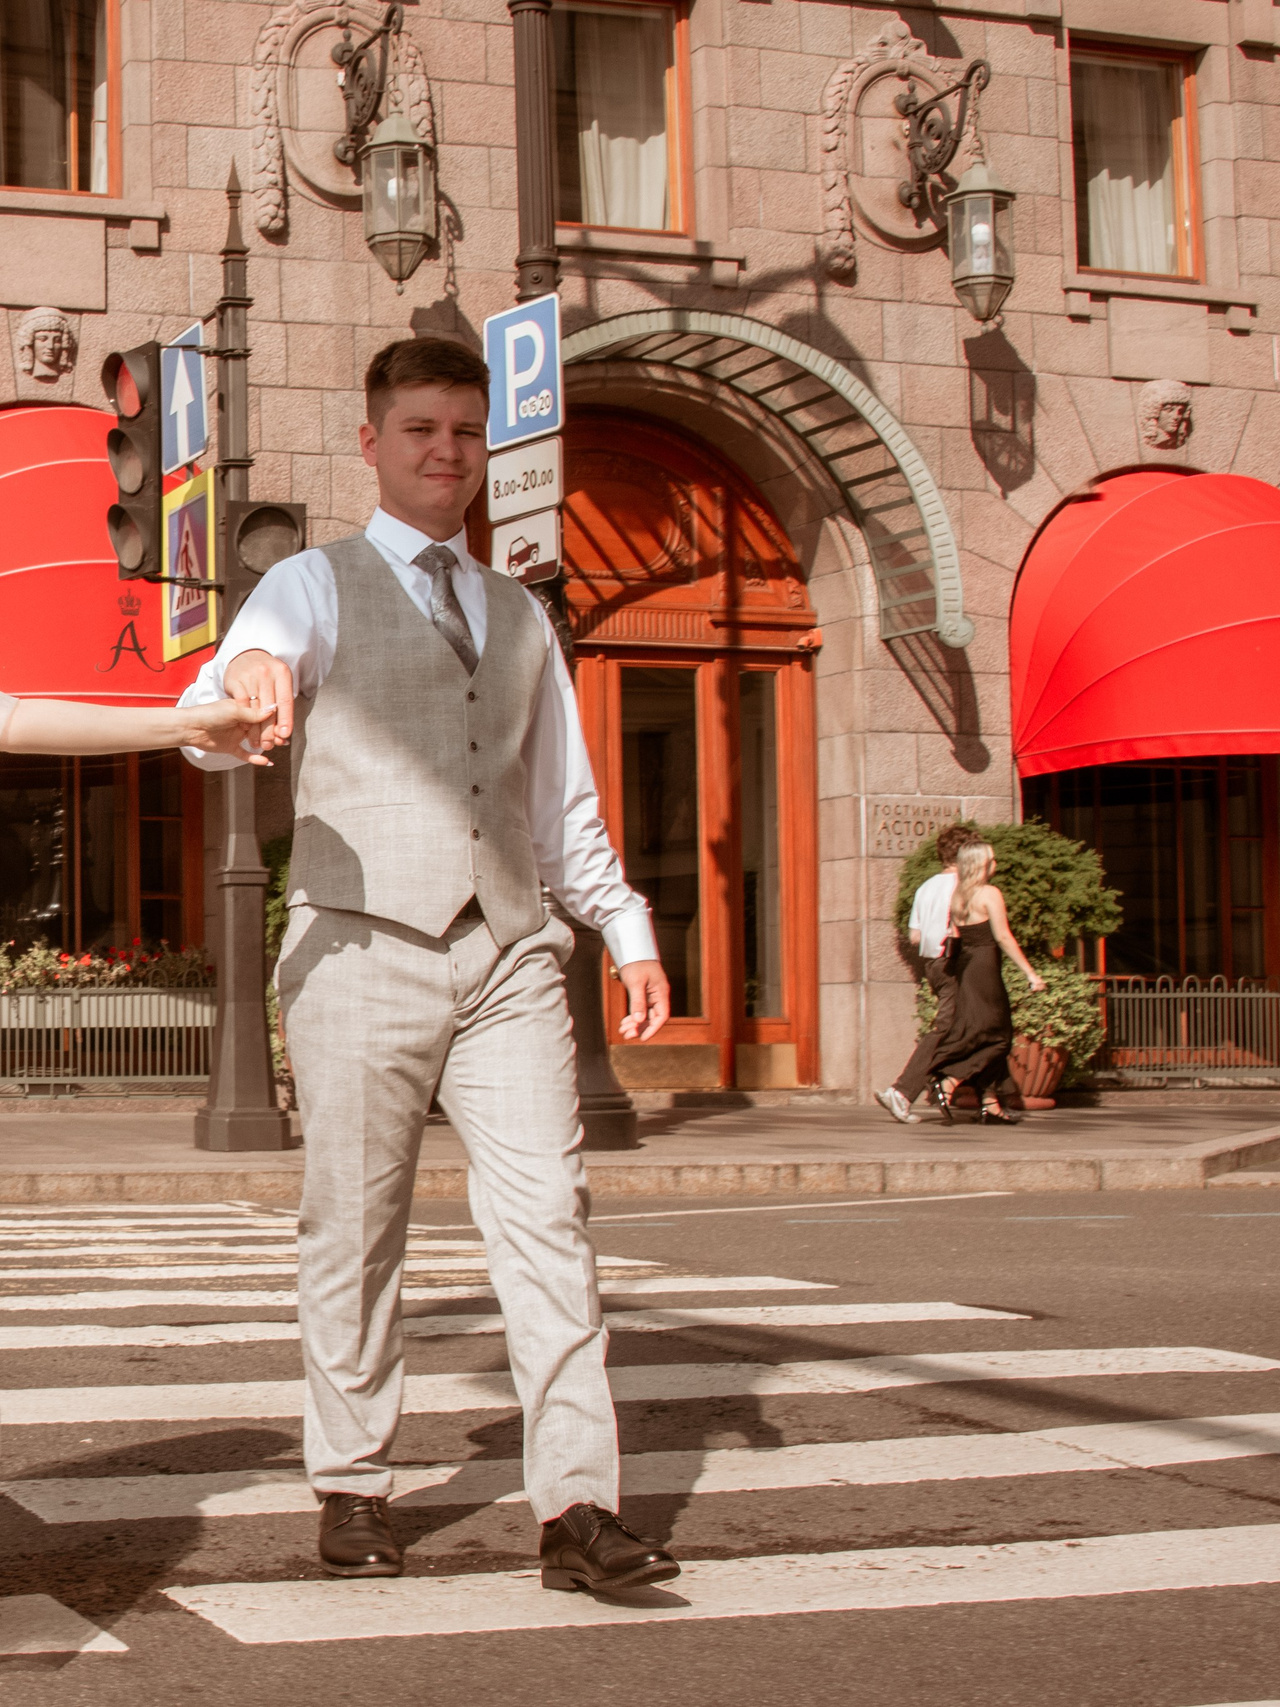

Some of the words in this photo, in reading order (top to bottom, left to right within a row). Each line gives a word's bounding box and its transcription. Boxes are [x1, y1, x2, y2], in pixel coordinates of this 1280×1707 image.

[505, 320, 544, 427] P
[540, 395, 550, 410] 20
[494, 469, 553, 499] 8.00-20.00
[95, 620, 165, 673] A
[877, 820, 939, 837] АСТОР
